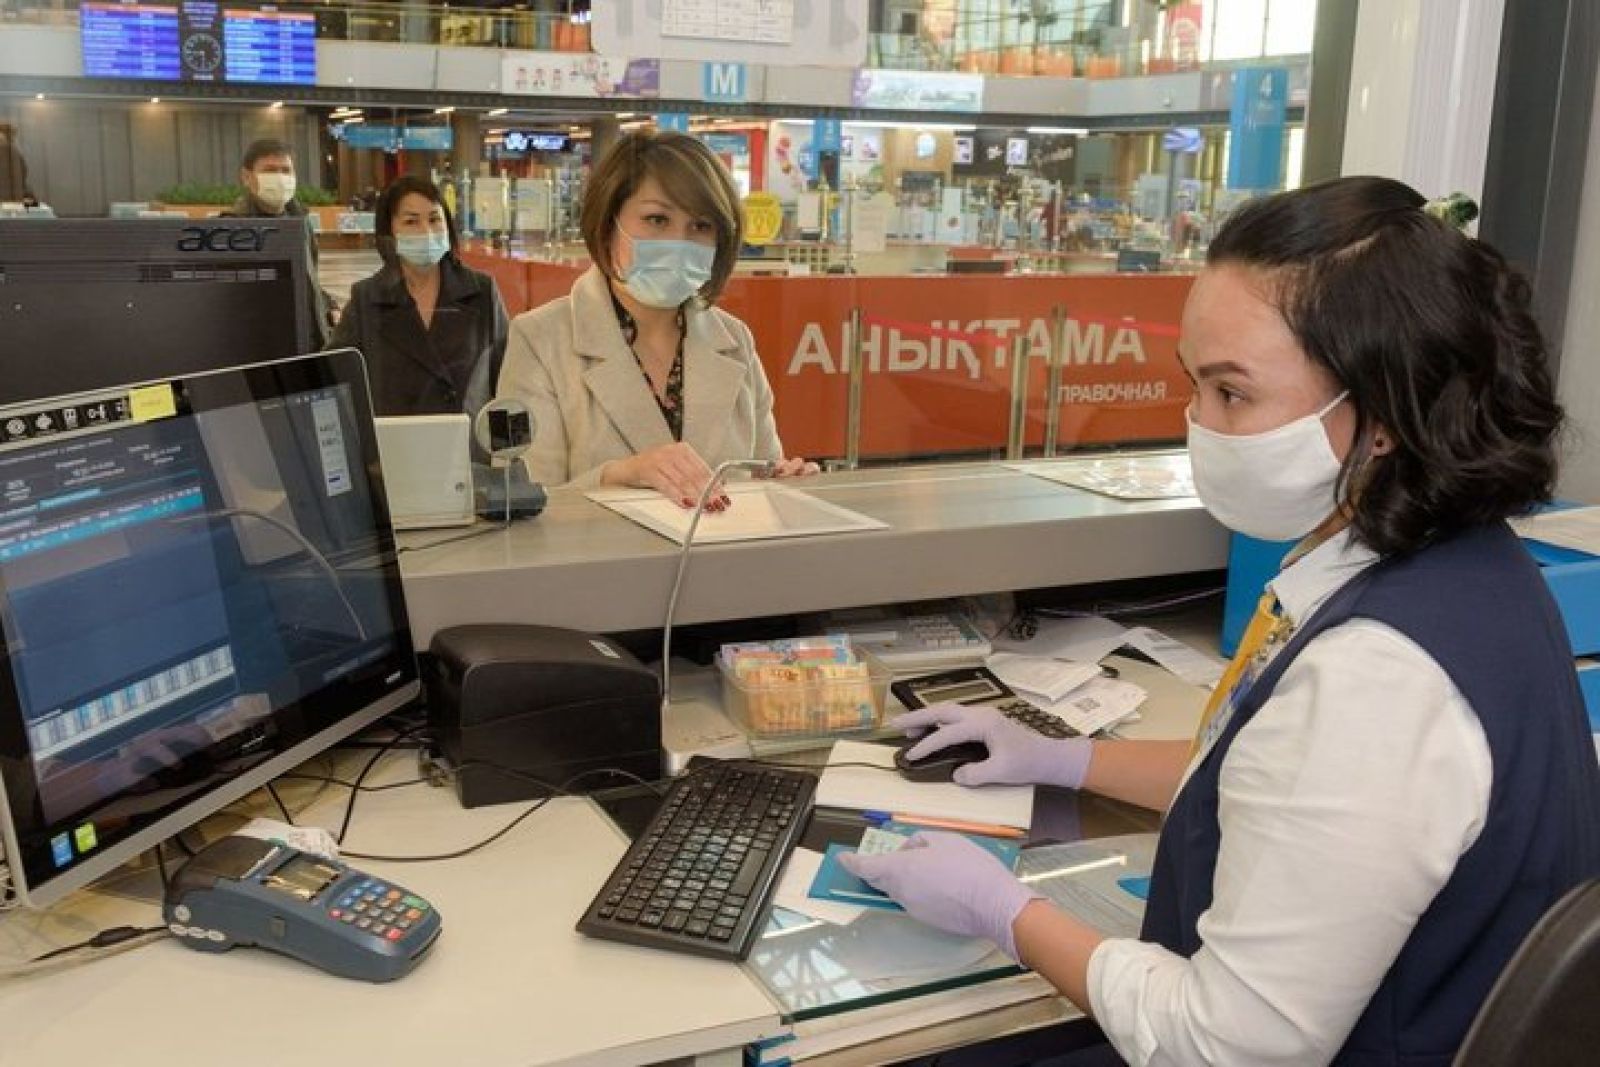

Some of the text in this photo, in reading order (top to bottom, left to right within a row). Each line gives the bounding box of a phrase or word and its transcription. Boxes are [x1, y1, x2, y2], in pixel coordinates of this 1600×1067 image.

[1259, 72, 1273, 97] 4
[176, 227, 281, 252] acer
[787, 316, 1146, 380] АНЫҚТАМА
[1044, 381, 1168, 403] ПРАВОЧНАЯ
